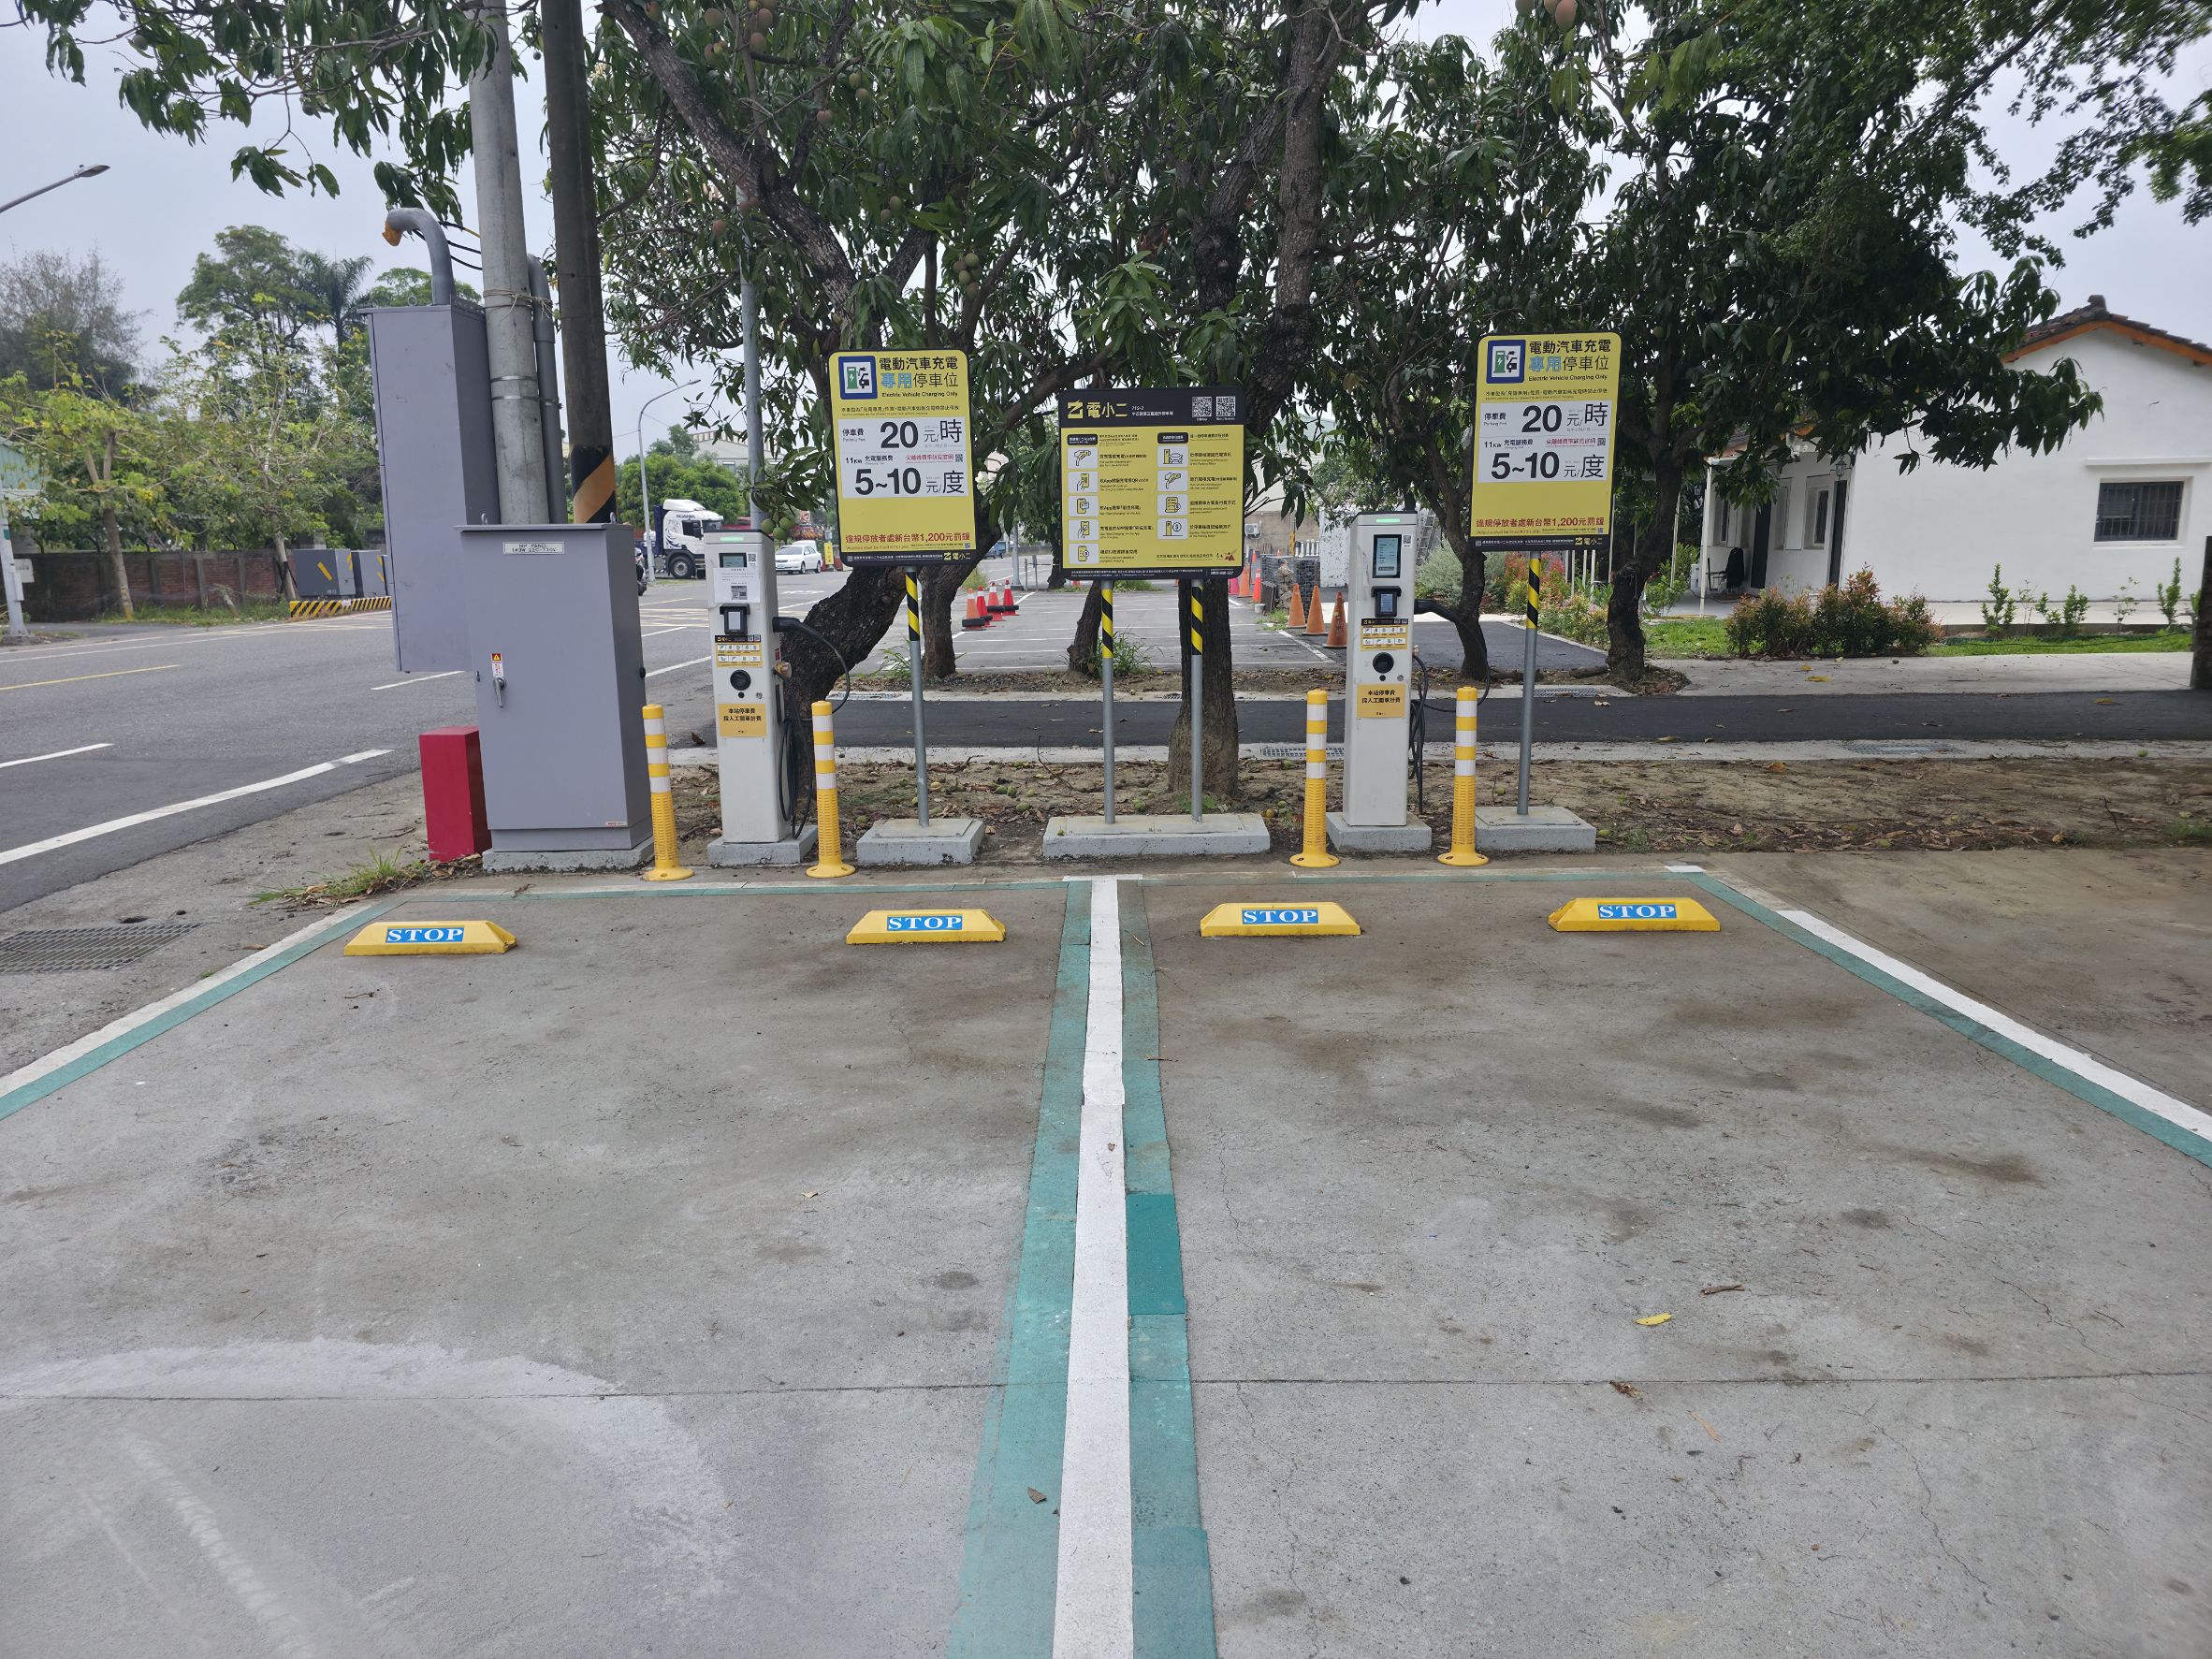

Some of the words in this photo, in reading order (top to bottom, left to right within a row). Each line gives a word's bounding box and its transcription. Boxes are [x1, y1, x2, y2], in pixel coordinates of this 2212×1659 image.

[1529, 339, 1611, 354] 電動汽車充電
[880, 357, 958, 371] 電動汽車充電
[1529, 356, 1609, 372] 專用停車位
[880, 372, 958, 388] 專用停車位
[1521, 404, 1563, 432] 20
[842, 428, 865, 437] 停車費
[880, 421, 919, 448] 20
[1491, 451, 1560, 479] 5~10
[854, 467, 922, 496] 5~10
[1244, 910, 1317, 923] STOP
[1600, 903, 1675, 918] STOP
[889, 916, 961, 929] STOP
[387, 928, 463, 941] STOP
